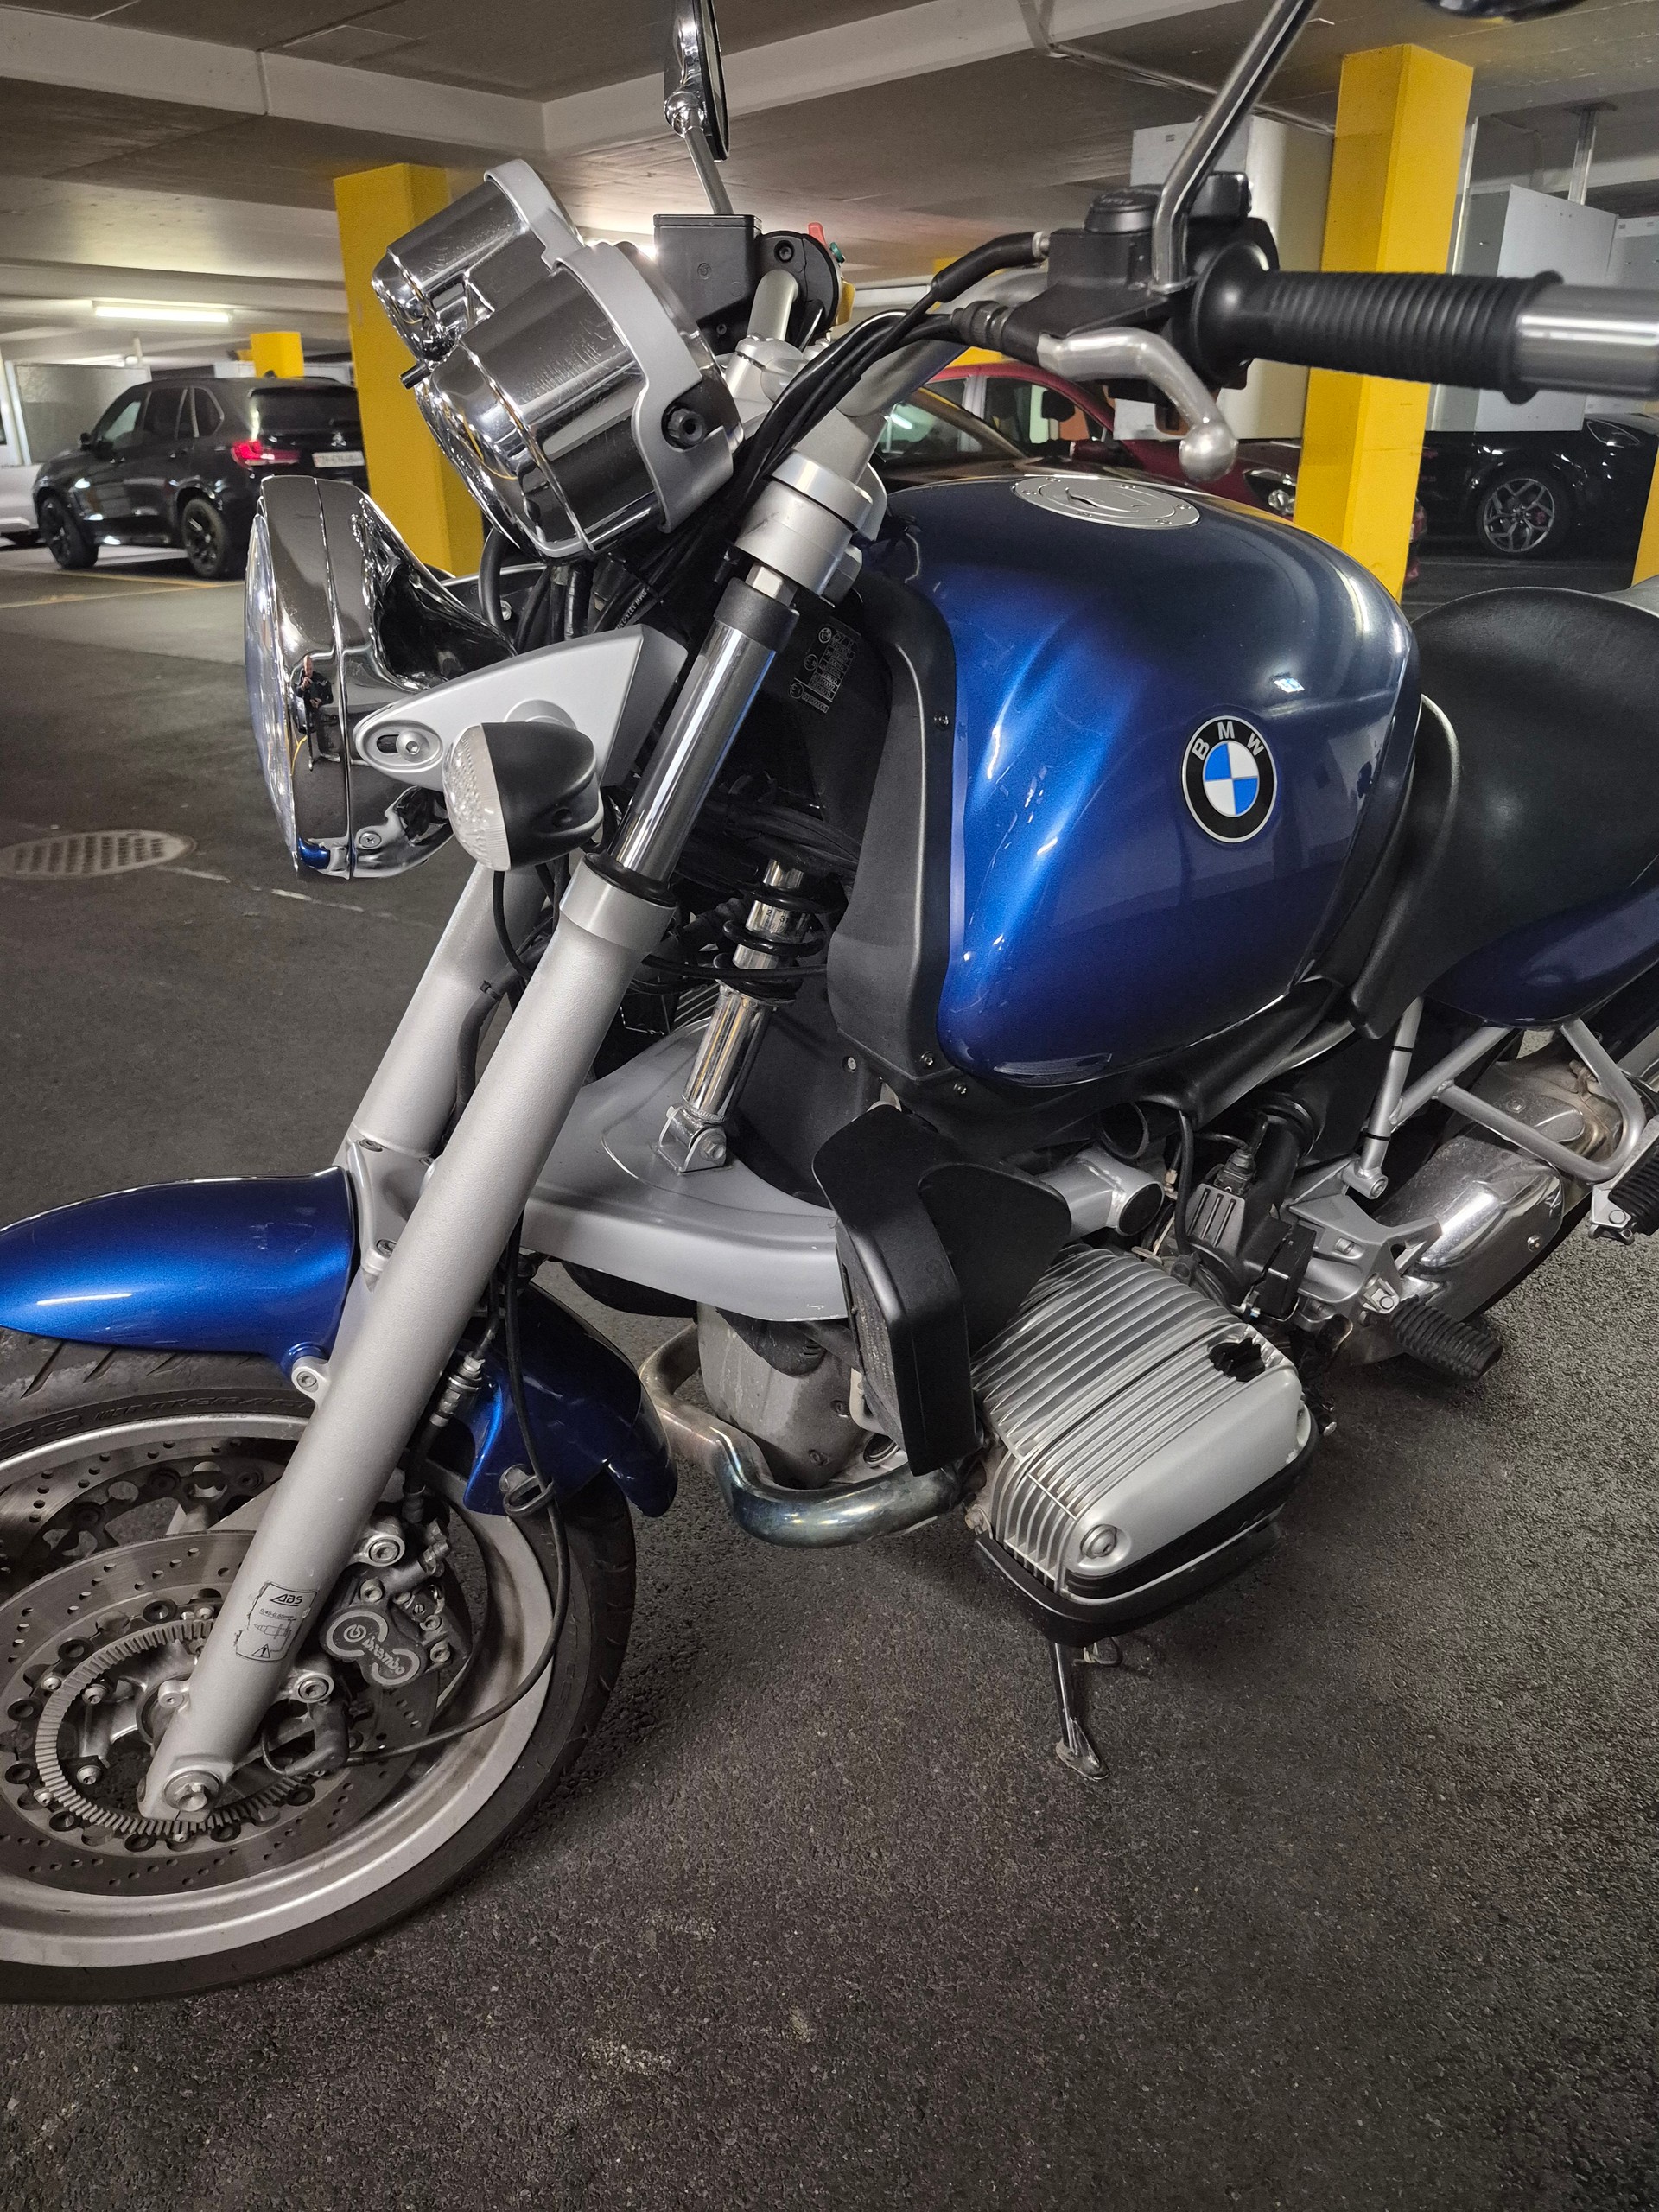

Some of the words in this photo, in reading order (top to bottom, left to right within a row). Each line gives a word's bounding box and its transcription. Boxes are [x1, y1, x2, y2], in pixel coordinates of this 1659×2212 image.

[1192, 721, 1265, 760] BMW
[270, 1593, 302, 1606] ABS
[362, 1636, 405, 1675] brembo
